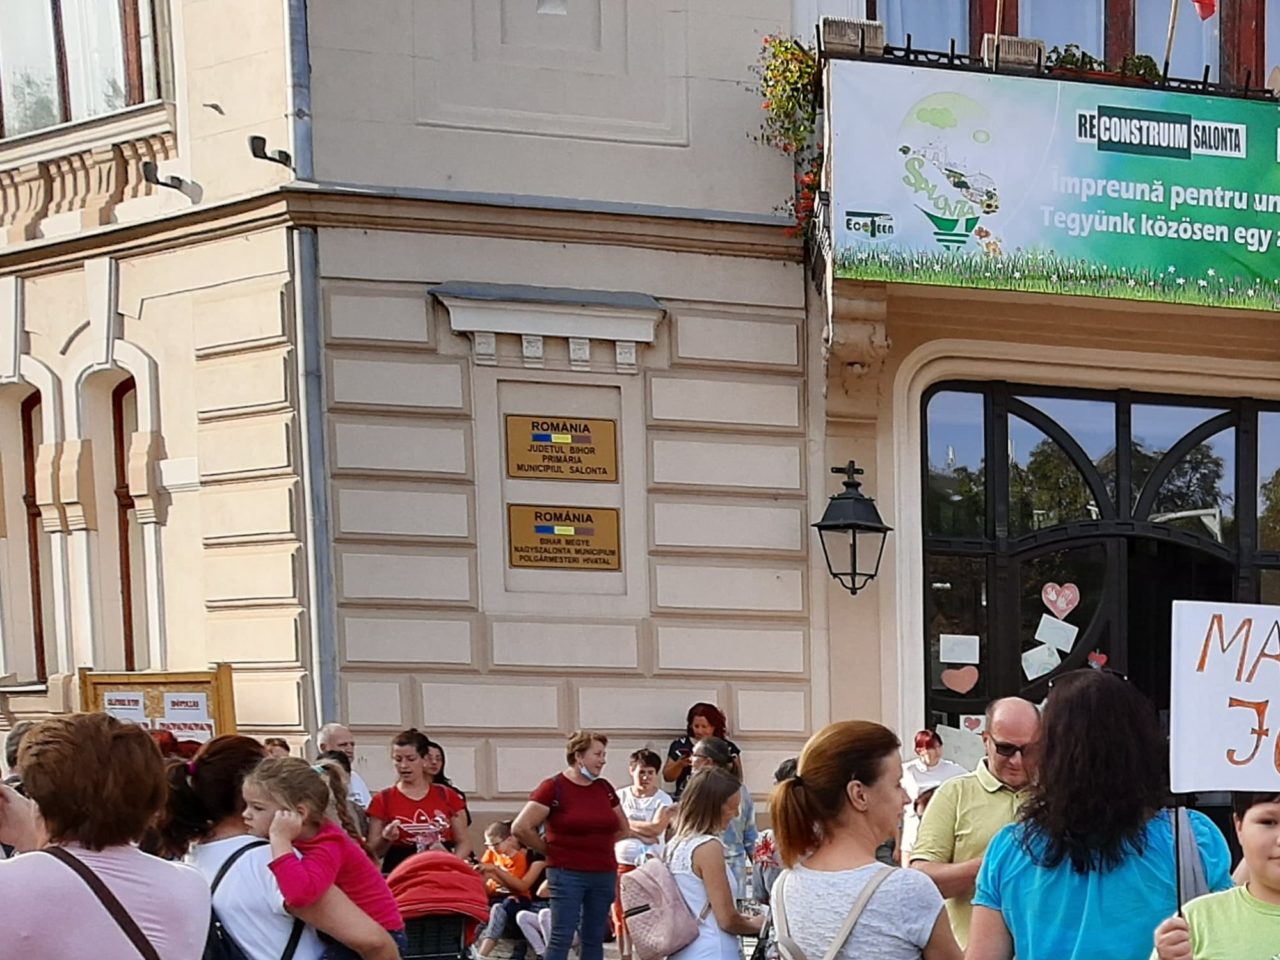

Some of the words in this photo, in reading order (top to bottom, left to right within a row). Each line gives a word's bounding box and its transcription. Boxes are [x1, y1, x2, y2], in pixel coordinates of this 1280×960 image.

[1194, 125, 1242, 153] SALONTA
[1170, 185, 1248, 210] pentru
[1040, 205, 1136, 236] Tegyünk
[1141, 214, 1228, 242] közösen
[1234, 229, 1272, 253] egy
[570, 447, 596, 455] BIHOR
[517, 464, 565, 474] MUNICIPIUL
[569, 466, 608, 474] SALONTA
